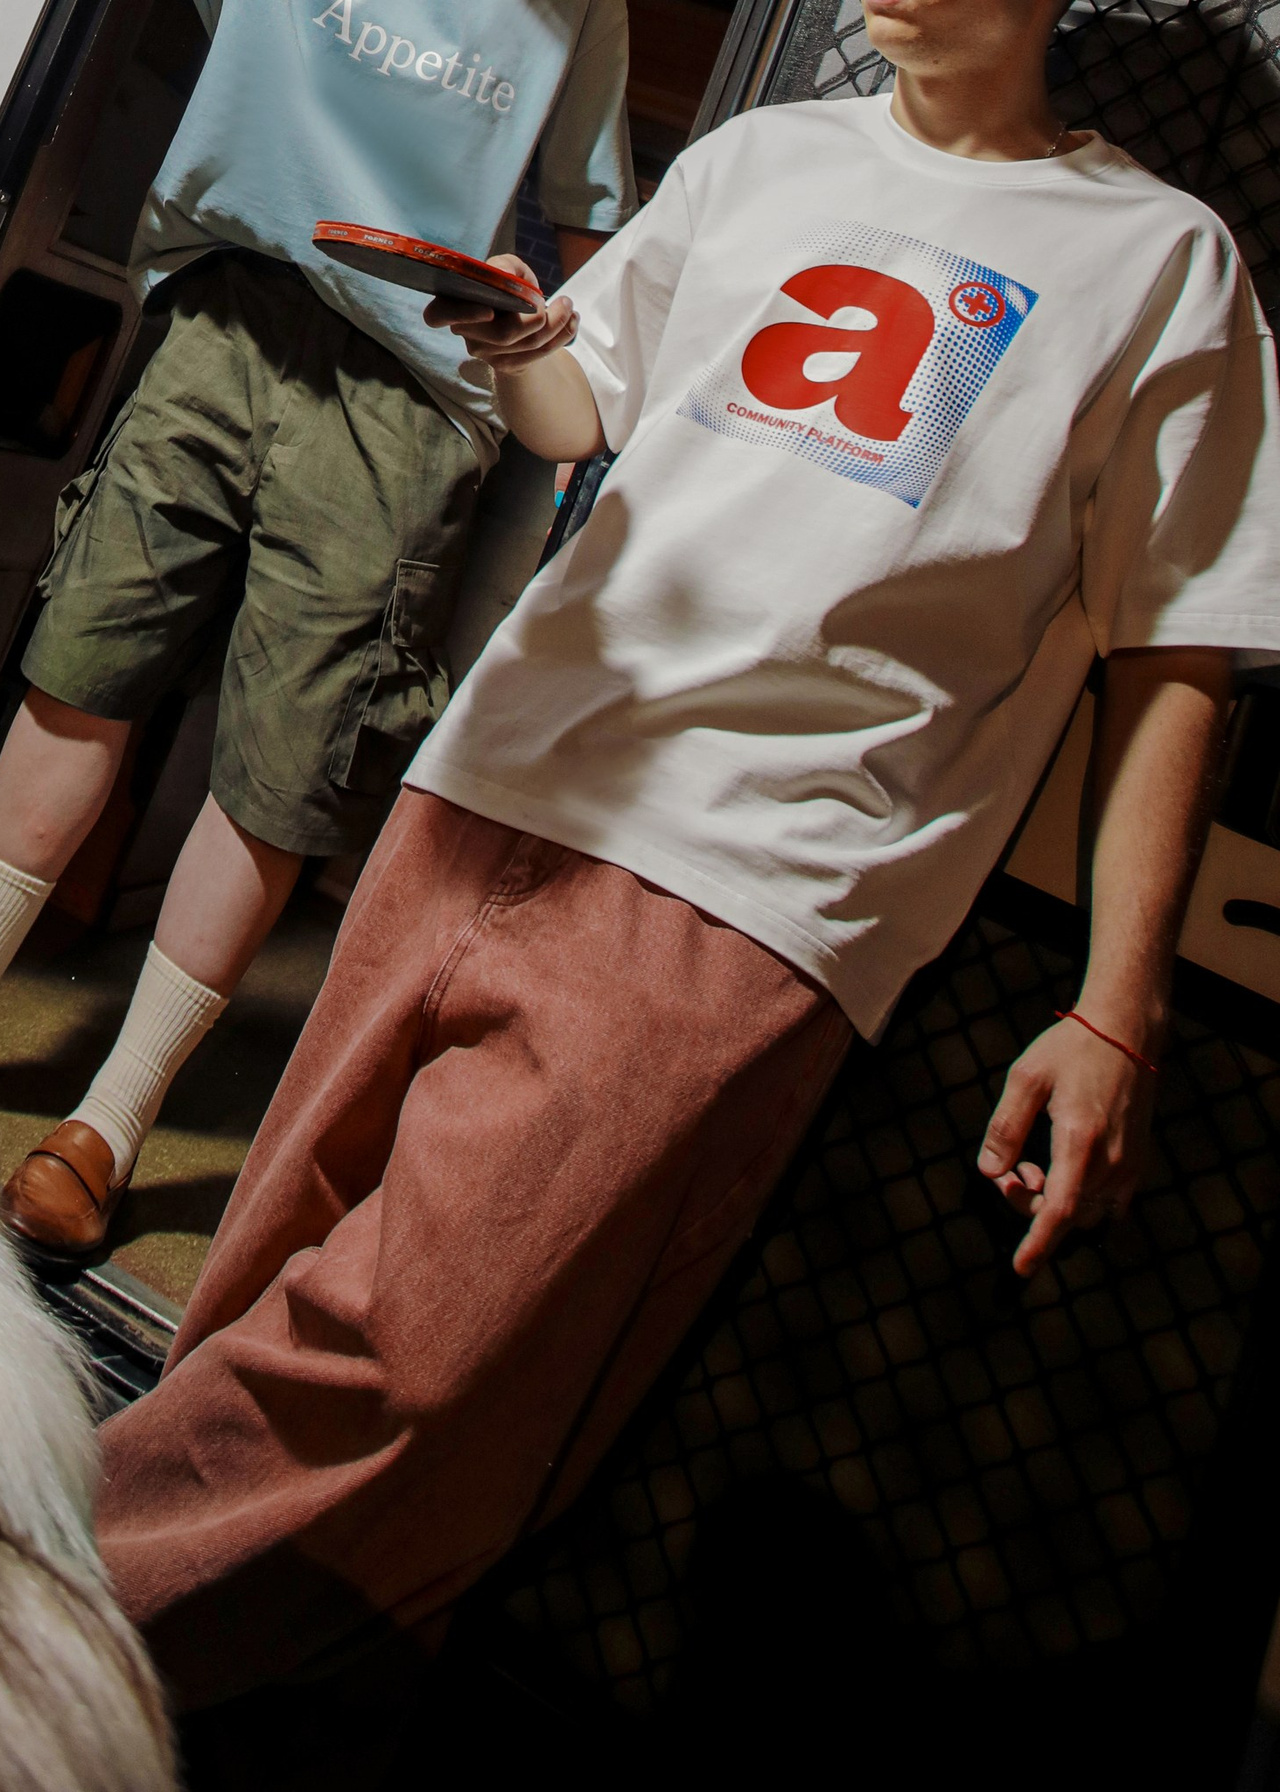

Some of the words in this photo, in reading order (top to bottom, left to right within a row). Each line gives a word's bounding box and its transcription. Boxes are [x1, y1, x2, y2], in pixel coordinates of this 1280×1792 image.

[741, 264, 936, 442] a
[726, 402, 807, 434] COMMUNITY
[806, 426, 884, 465] PLATFORM
